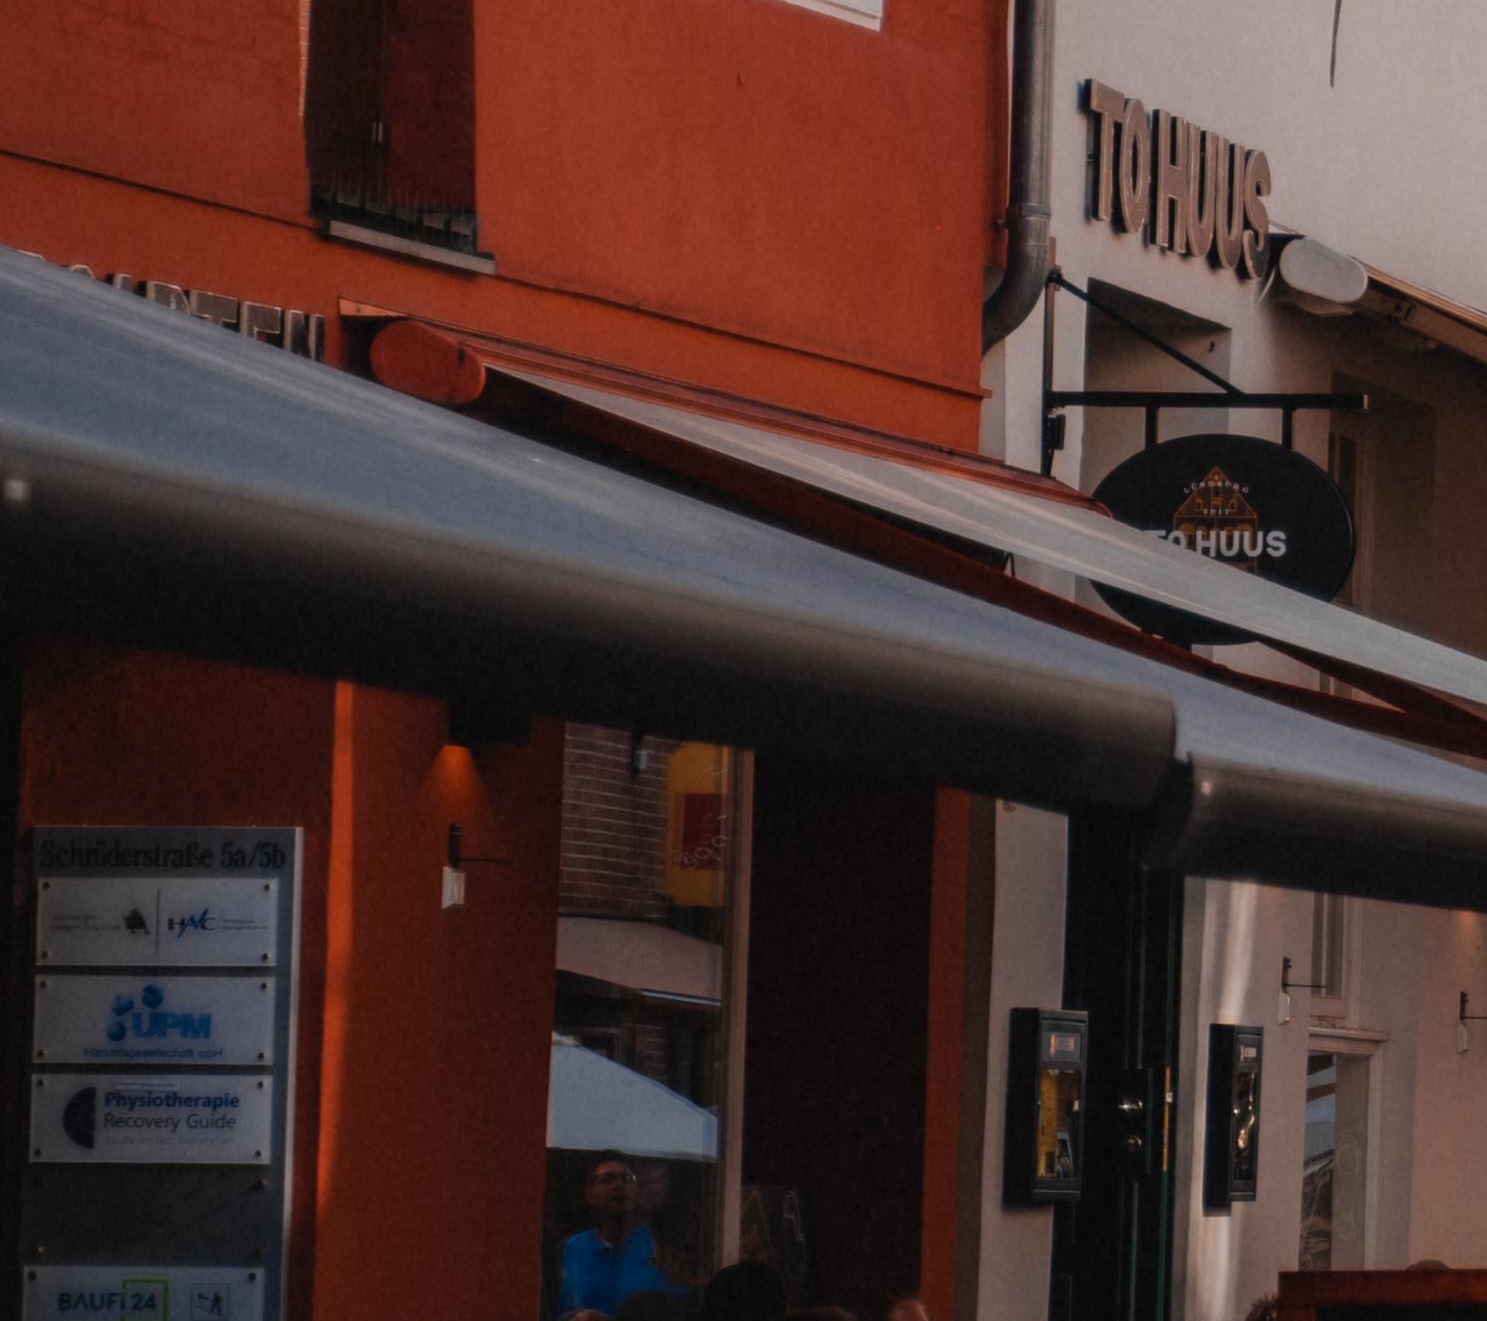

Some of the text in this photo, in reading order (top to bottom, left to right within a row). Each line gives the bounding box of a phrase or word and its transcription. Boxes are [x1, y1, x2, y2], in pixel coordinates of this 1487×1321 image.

[1151, 108, 1271, 280] HUUS
[1196, 529, 1287, 558] HUUS
[40, 839, 286, 869] Schröderstraße 5a/5b
[131, 1012, 212, 1039] UPM
[104, 1090, 240, 1111] Physiotherapie
[103, 1112, 237, 1132] Recovery Guide
